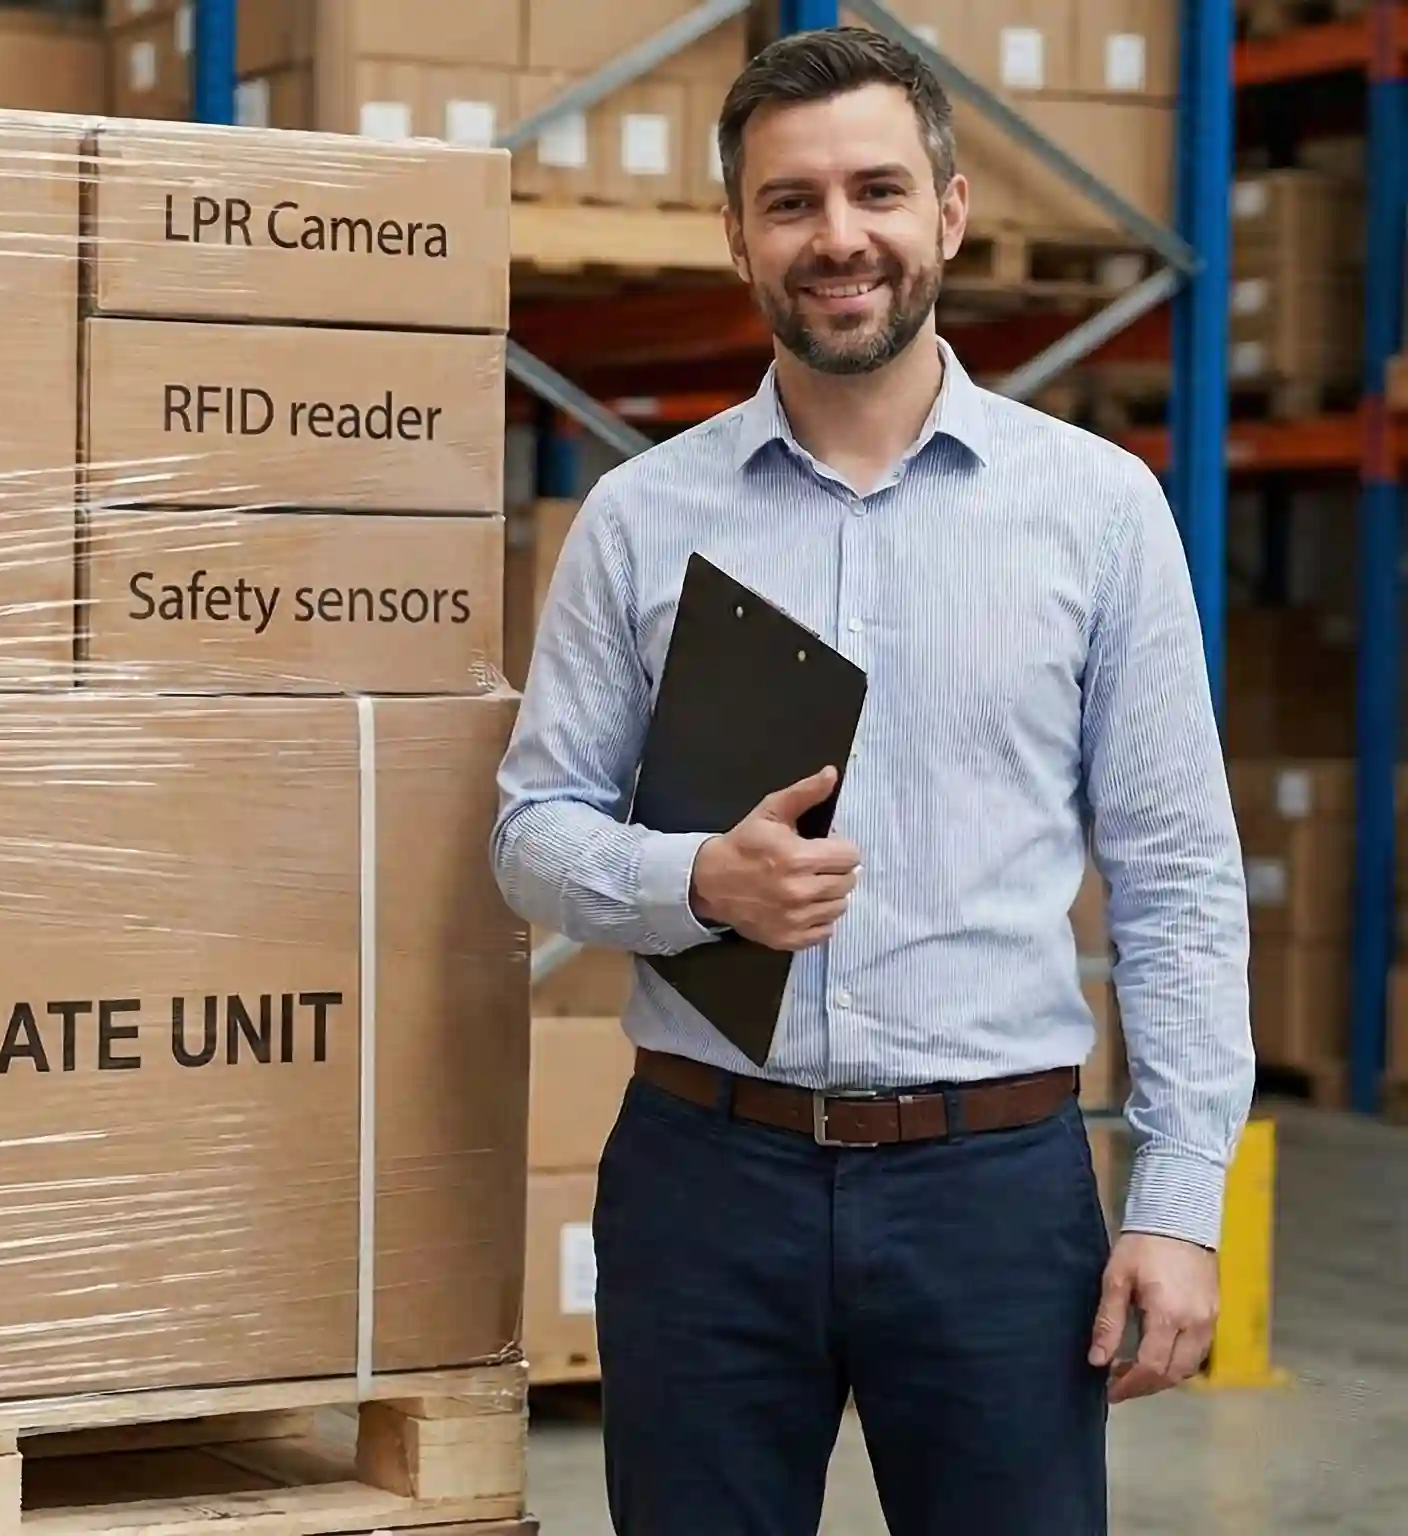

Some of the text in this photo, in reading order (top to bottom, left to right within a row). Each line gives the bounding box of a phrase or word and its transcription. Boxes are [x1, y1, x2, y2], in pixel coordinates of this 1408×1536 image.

[165, 194, 448, 258] LPR Camera
[164, 384, 442, 441] RFID reader
[129, 570, 471, 635] Safety sensors
[171, 990, 344, 1068] UNIT
